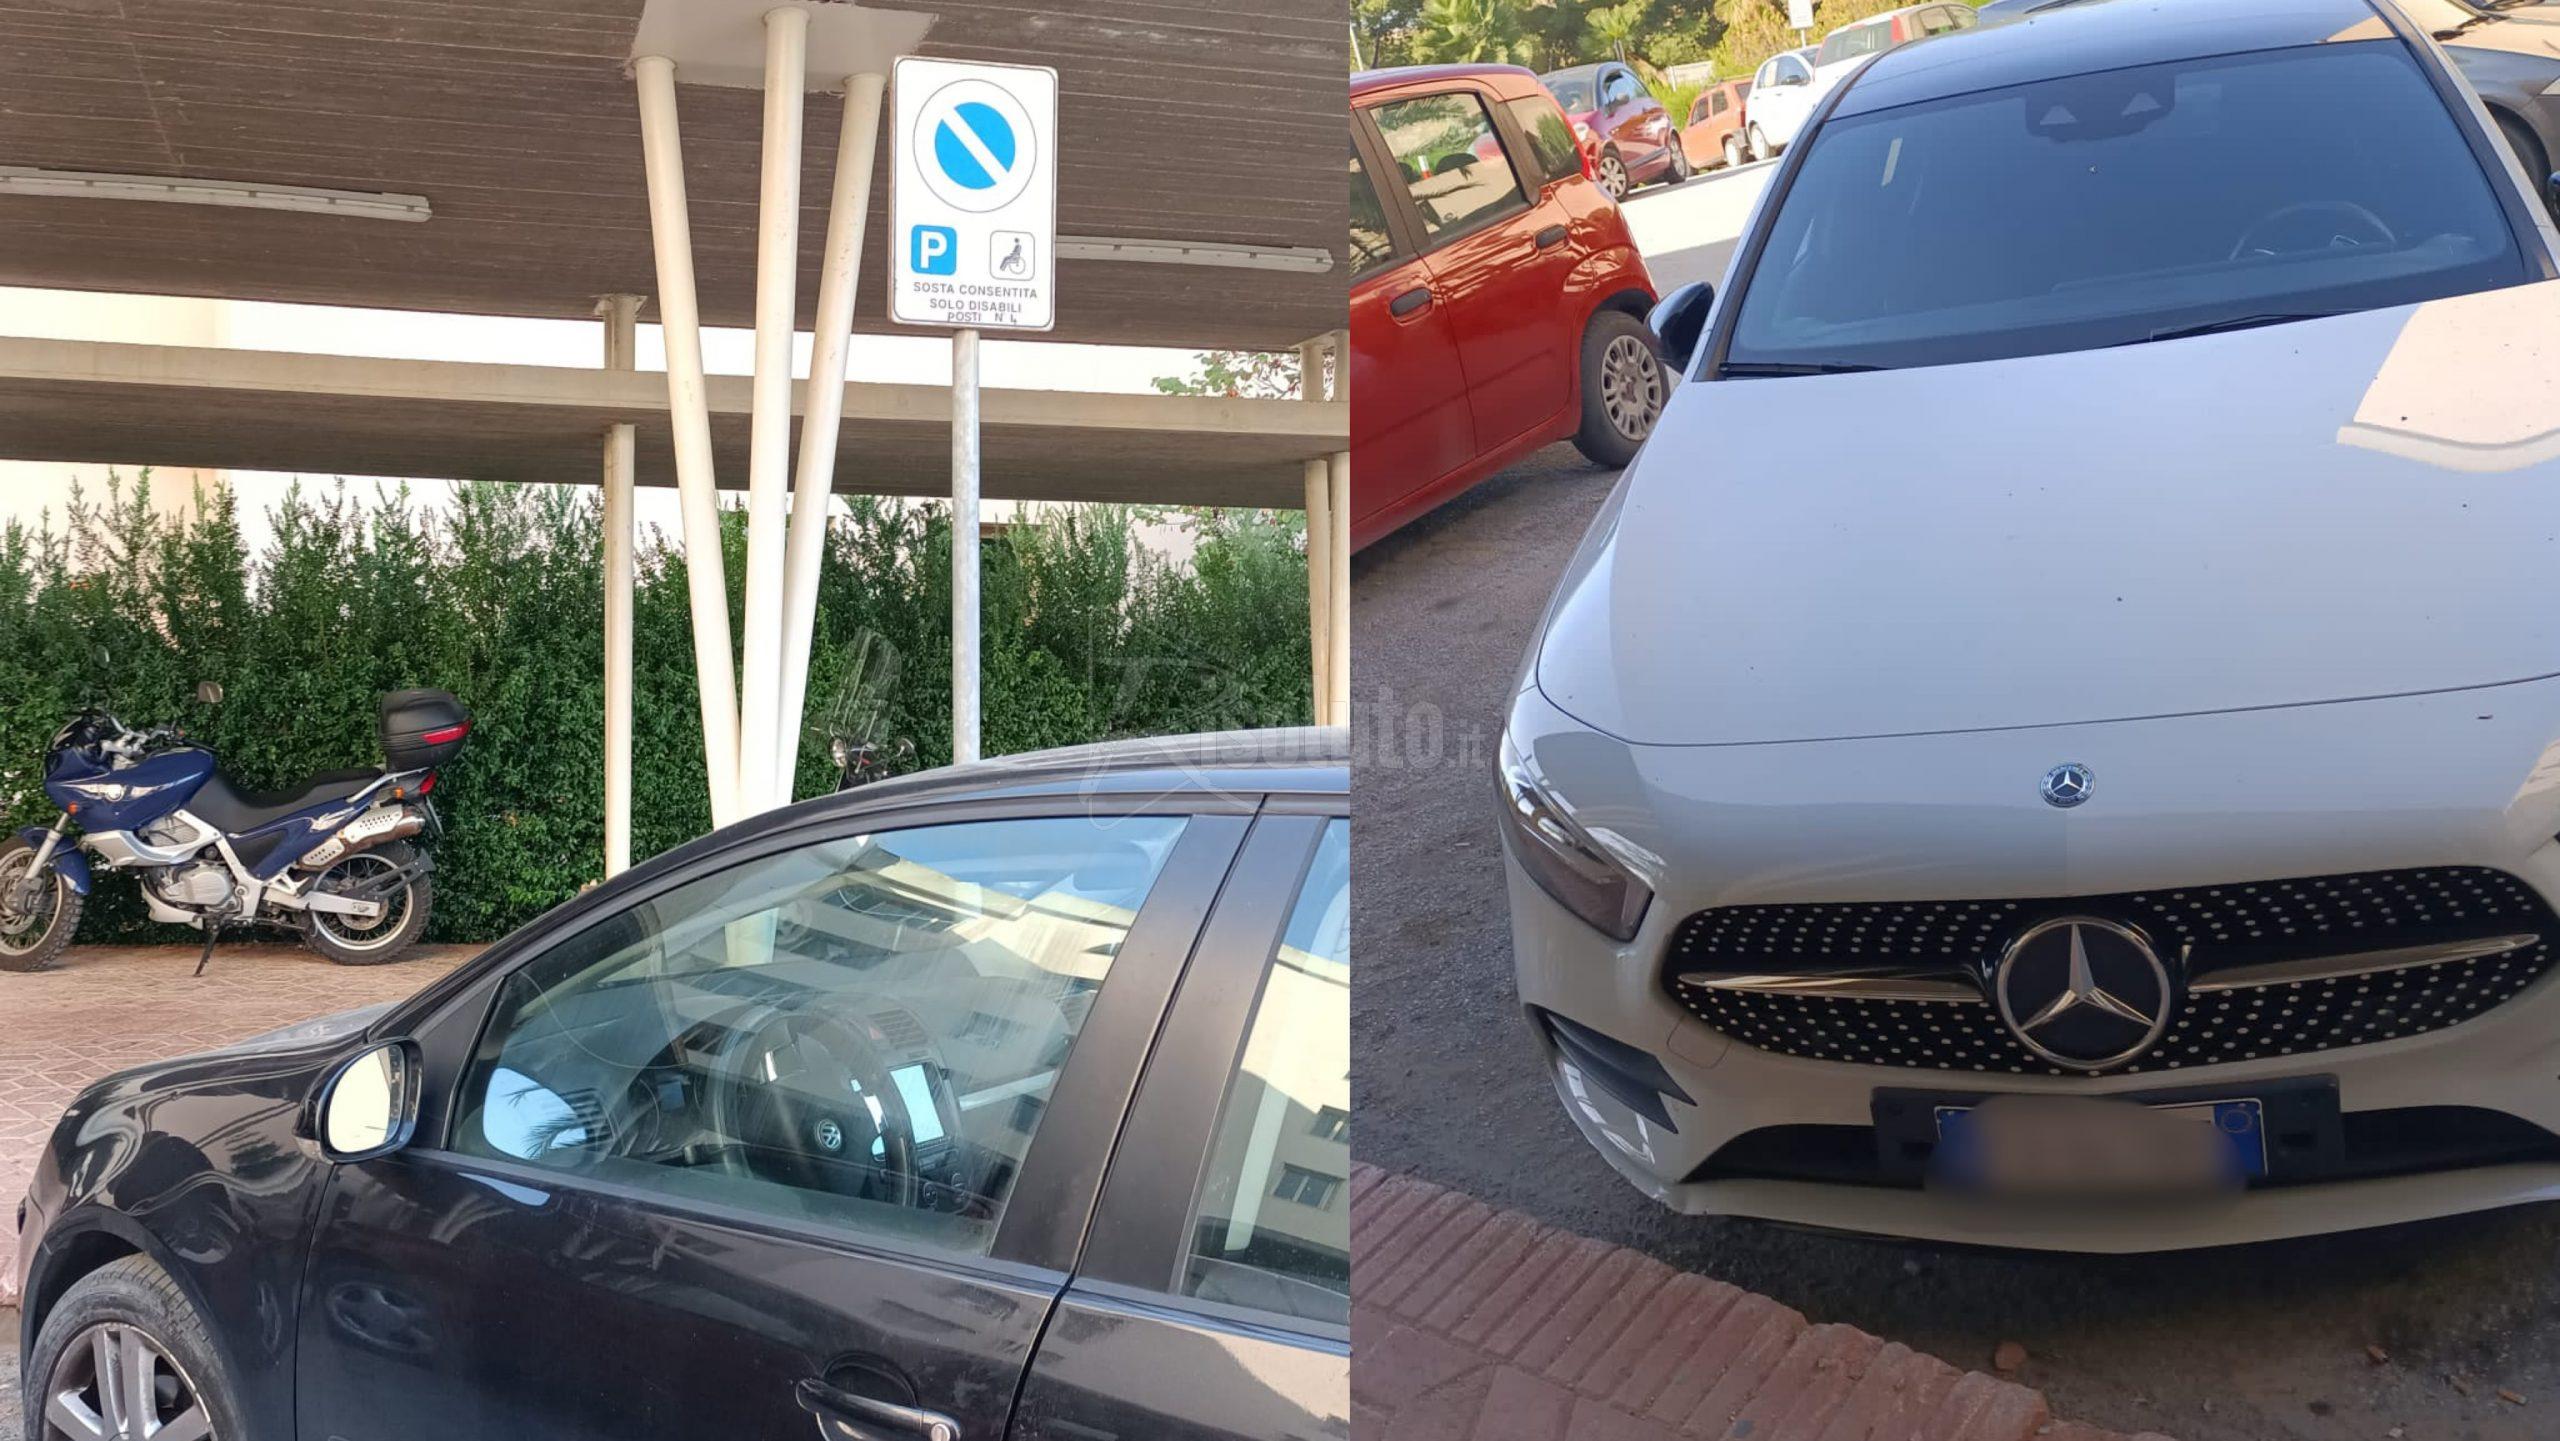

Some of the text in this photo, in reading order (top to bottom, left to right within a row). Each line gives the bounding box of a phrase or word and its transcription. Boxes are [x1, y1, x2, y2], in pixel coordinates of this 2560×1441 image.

[920, 230, 948, 269] P
[913, 281, 1038, 299] SOSTA CONSENTITA
[930, 298, 1022, 313] SOLO DISABILI
[947, 311, 981, 323] POSTI
